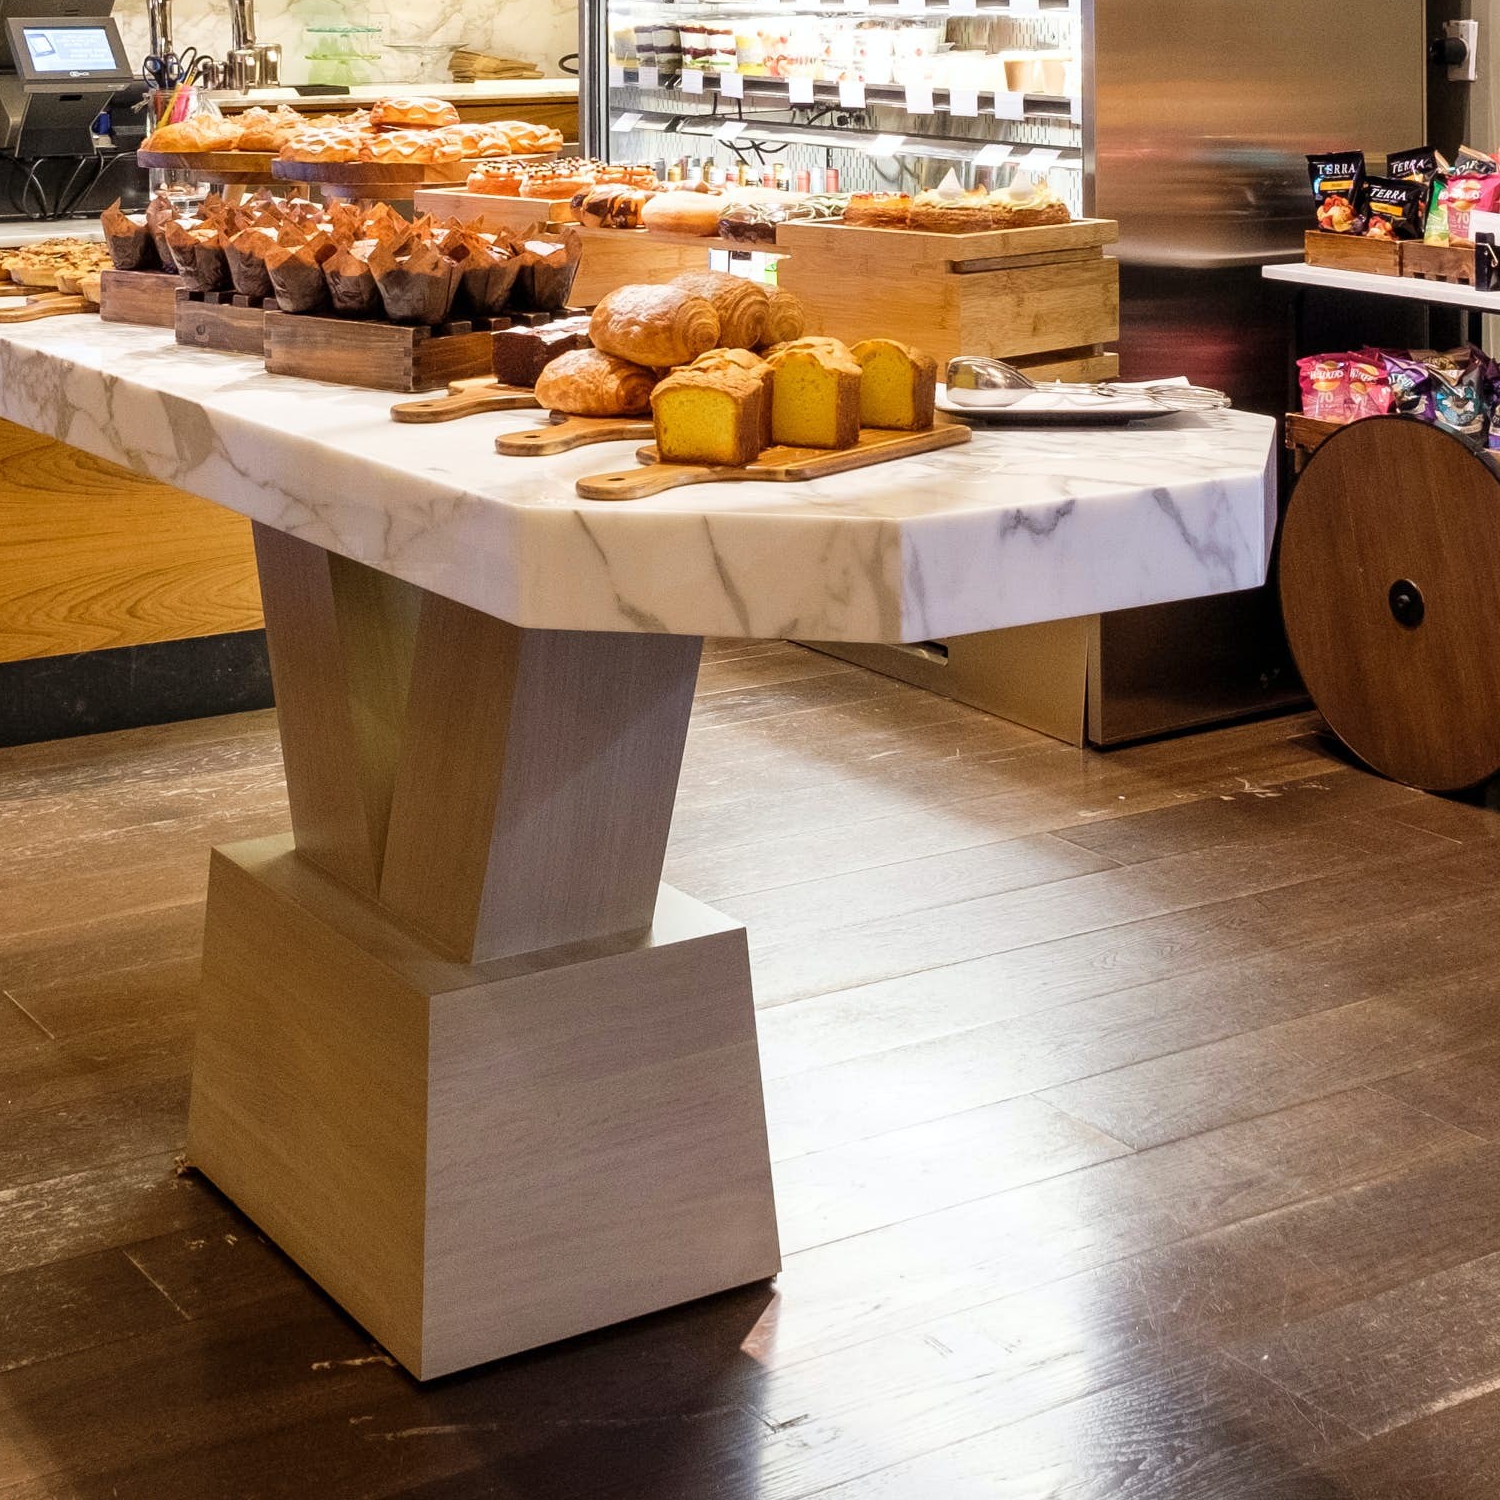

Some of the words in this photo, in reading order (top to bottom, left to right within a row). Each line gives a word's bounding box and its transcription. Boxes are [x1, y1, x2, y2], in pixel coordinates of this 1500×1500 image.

[1317, 162, 1356, 175] TERRA
[1392, 158, 1426, 175] TERRA
[1370, 187, 1407, 201] TERRA
